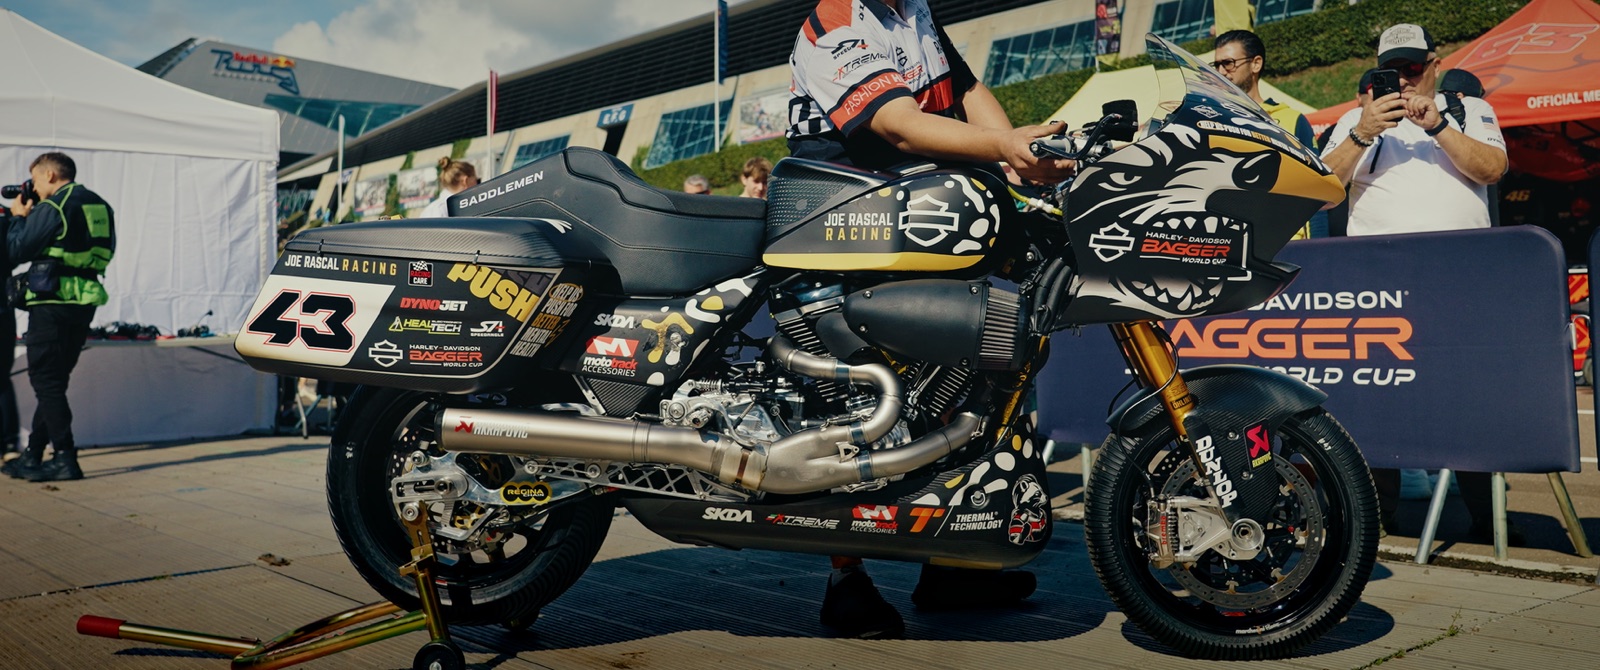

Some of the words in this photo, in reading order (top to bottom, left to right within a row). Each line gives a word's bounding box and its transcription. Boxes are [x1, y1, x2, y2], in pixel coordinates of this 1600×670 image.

[844, 76, 892, 115] FASHION
[1526, 92, 1582, 109] OFFICIAL
[459, 170, 544, 209] SADDLEMEN
[1505, 190, 1531, 202] 46
[824, 212, 845, 227] JOE
[848, 212, 894, 226] RASCAL
[825, 227, 891, 241] RACING
[1140, 239, 1231, 257] BAGGER
[284, 254, 302, 267] JOE
[304, 256, 340, 271] RASCAL
[342, 258, 397, 276] RACING
[1181, 257, 1210, 265] WORLD
[410, 270, 431, 278] RACING
[413, 277, 428, 285] CARE
[446, 263, 541, 323] PUSH
[400, 297, 468, 312] DYNOJET
[246, 288, 357, 353] 43
[593, 313, 635, 329] SKDA
[1158, 317, 1415, 361] AGGER
[409, 350, 483, 362] BAGGER
[583, 356, 638, 370] mototrack
[581, 365, 636, 377] ACCESSORIES
[1352, 367, 1416, 386] CUP
[1172, 395, 1192, 409] ÖHLIN
[1195, 435, 1238, 509] DUNLOP
[702, 506, 753, 523] SKDA
[850, 526, 897, 535] ACCESSORIES
[851, 520, 899, 529] mototrack
[950, 518, 1003, 531] TECHNOLOGY
[1160, 515, 1168, 545] brembo
